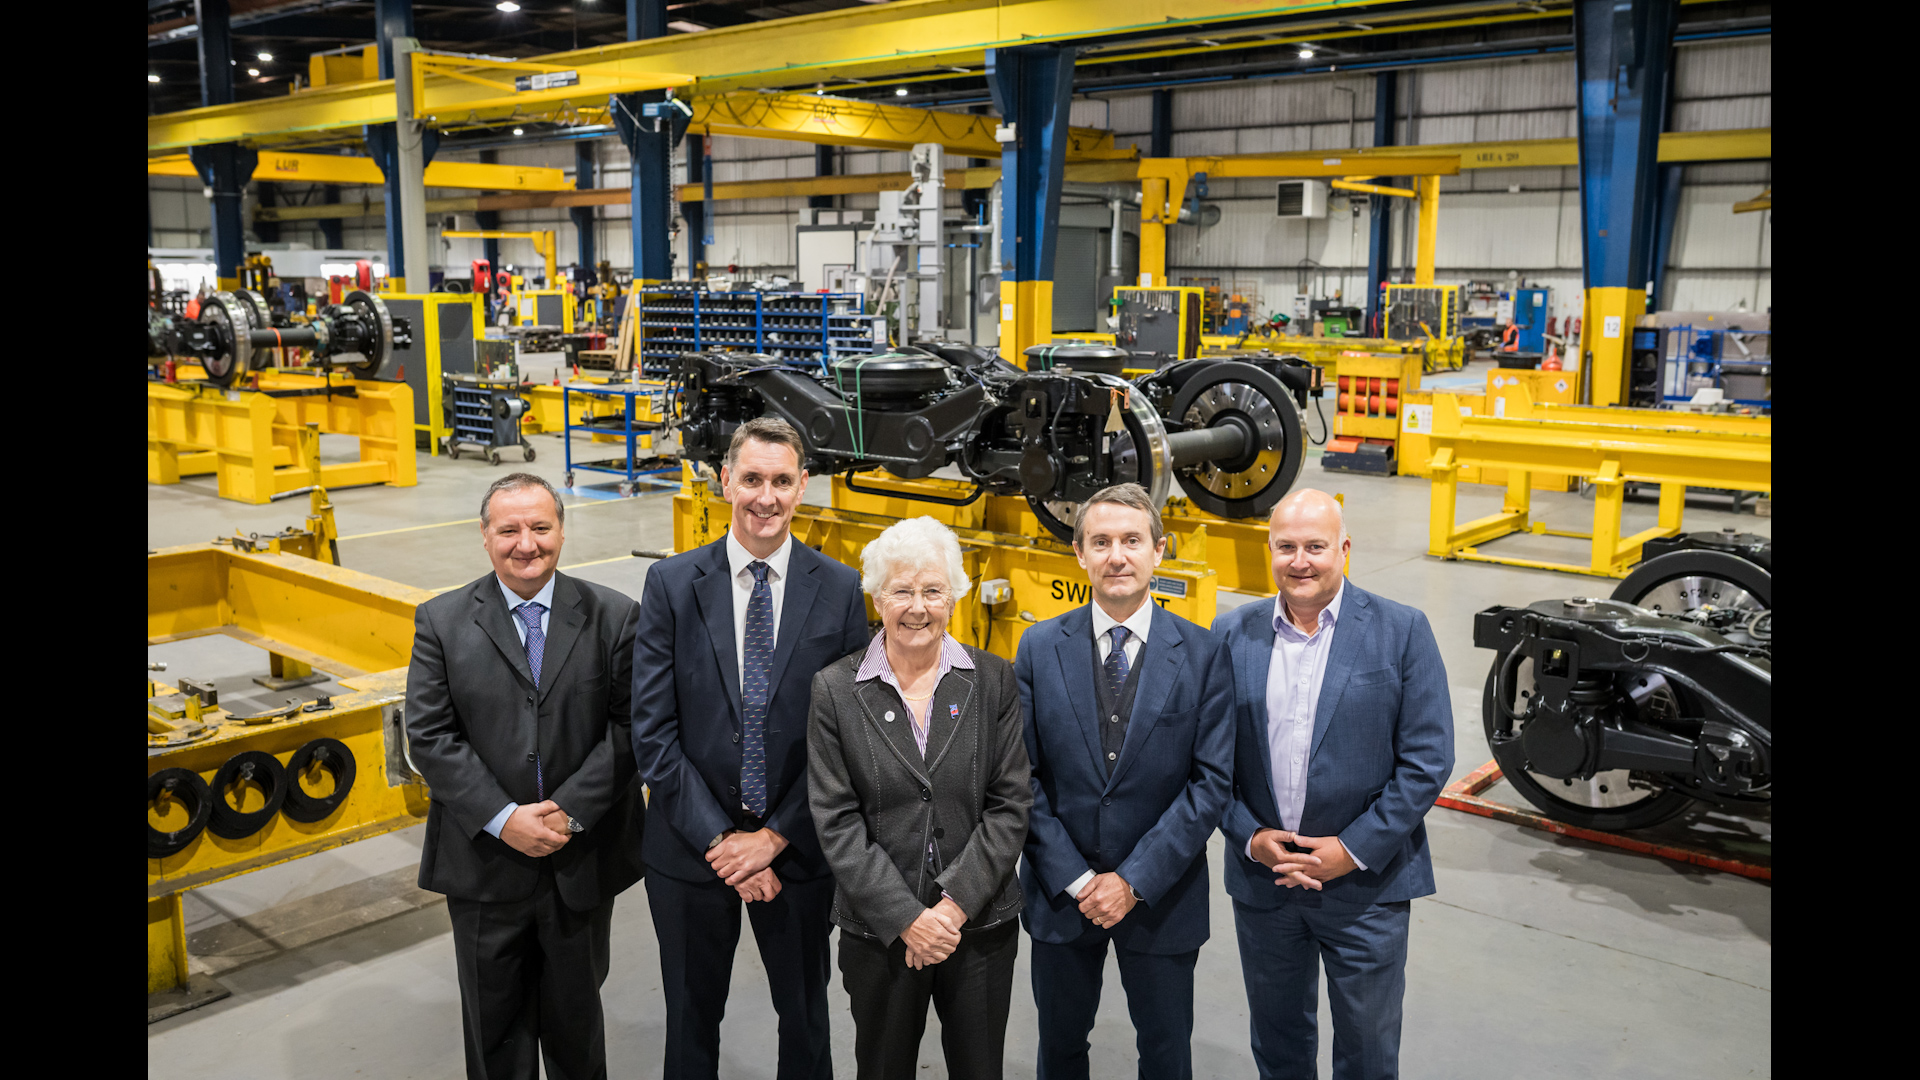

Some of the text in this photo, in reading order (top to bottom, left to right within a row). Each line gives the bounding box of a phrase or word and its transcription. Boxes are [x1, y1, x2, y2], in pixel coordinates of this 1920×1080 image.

[1073, 139, 1080, 151] 2
[275, 158, 299, 171] LUR
[517, 175, 523, 185] 3
[1606, 321, 1619, 332] 12
